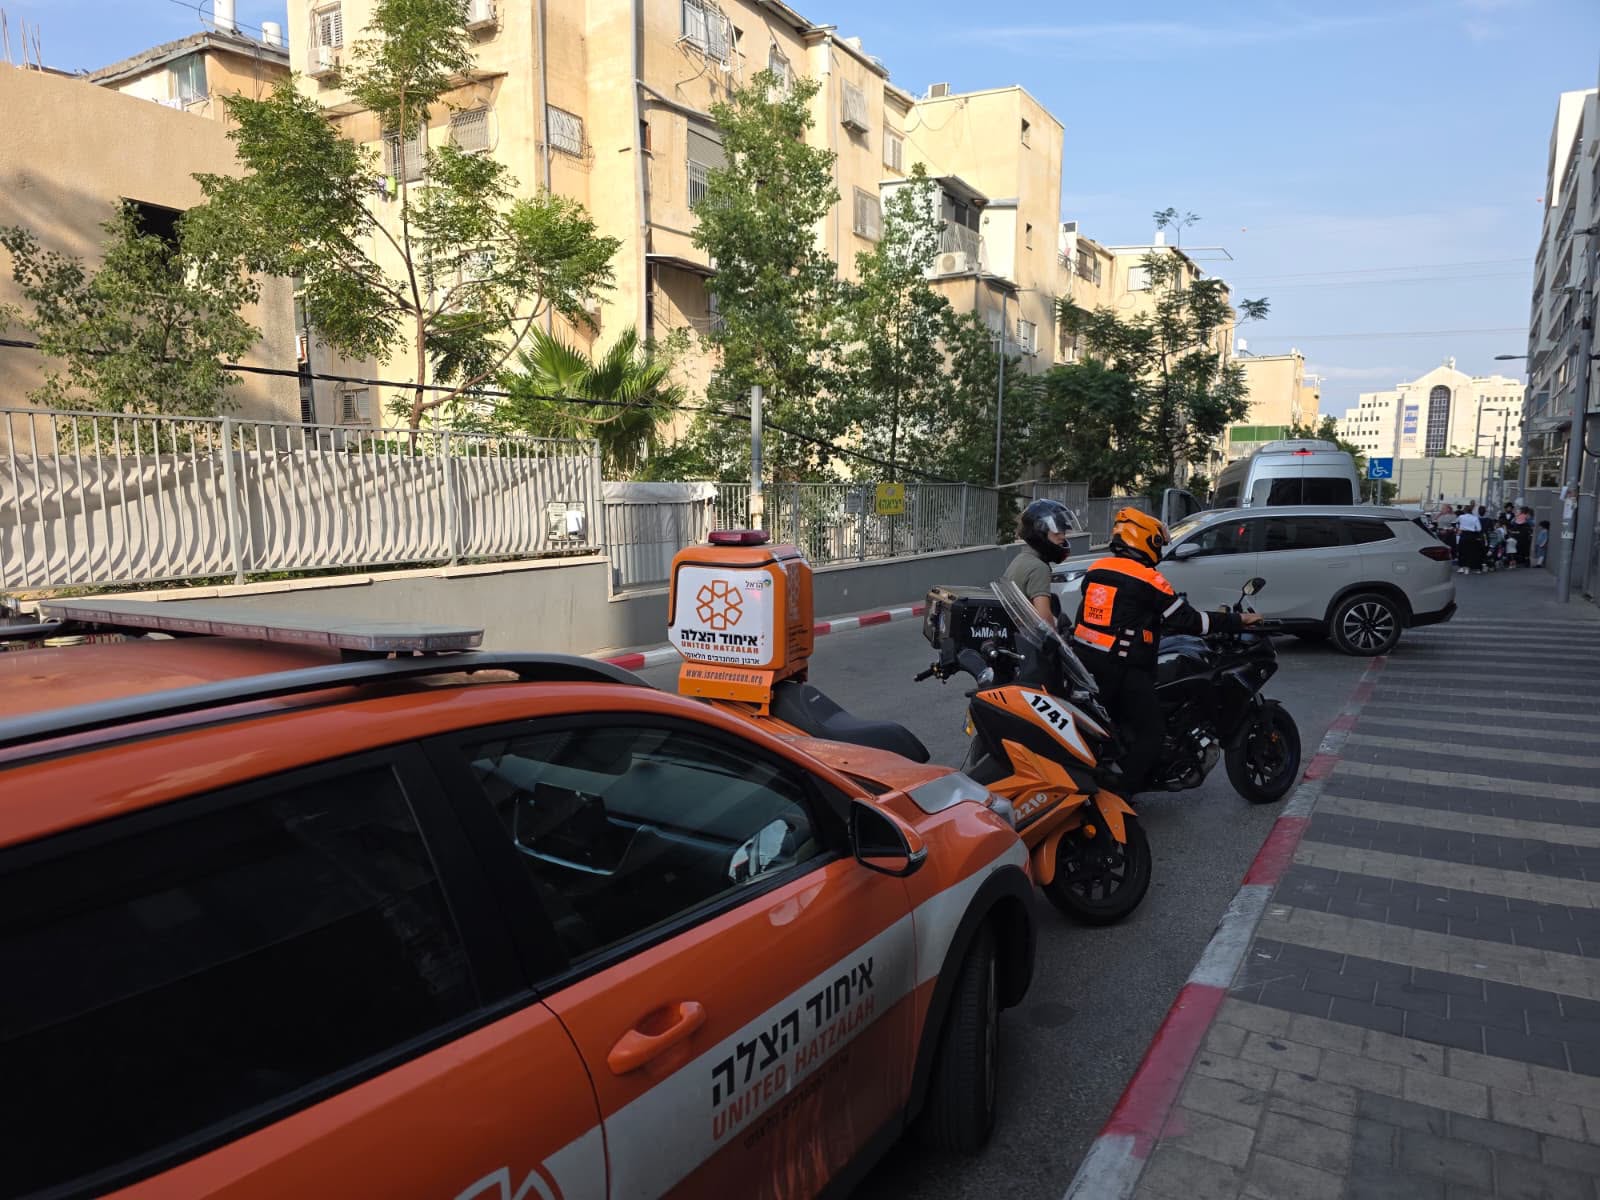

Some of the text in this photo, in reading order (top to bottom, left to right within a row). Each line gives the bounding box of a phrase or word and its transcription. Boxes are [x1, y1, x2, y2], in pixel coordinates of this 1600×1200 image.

[745, 580, 763, 589] הראל
[681, 629, 758, 647] איחוד הצלה
[681, 641, 759, 654] UNITED HATZALAH
[1031, 695, 1069, 730] 1741
[806, 956, 873, 1028] איחוד
[712, 1008, 800, 1108] הצלה
[712, 1063, 787, 1141] UNITED
[794, 994, 874, 1073] HATZALAH
